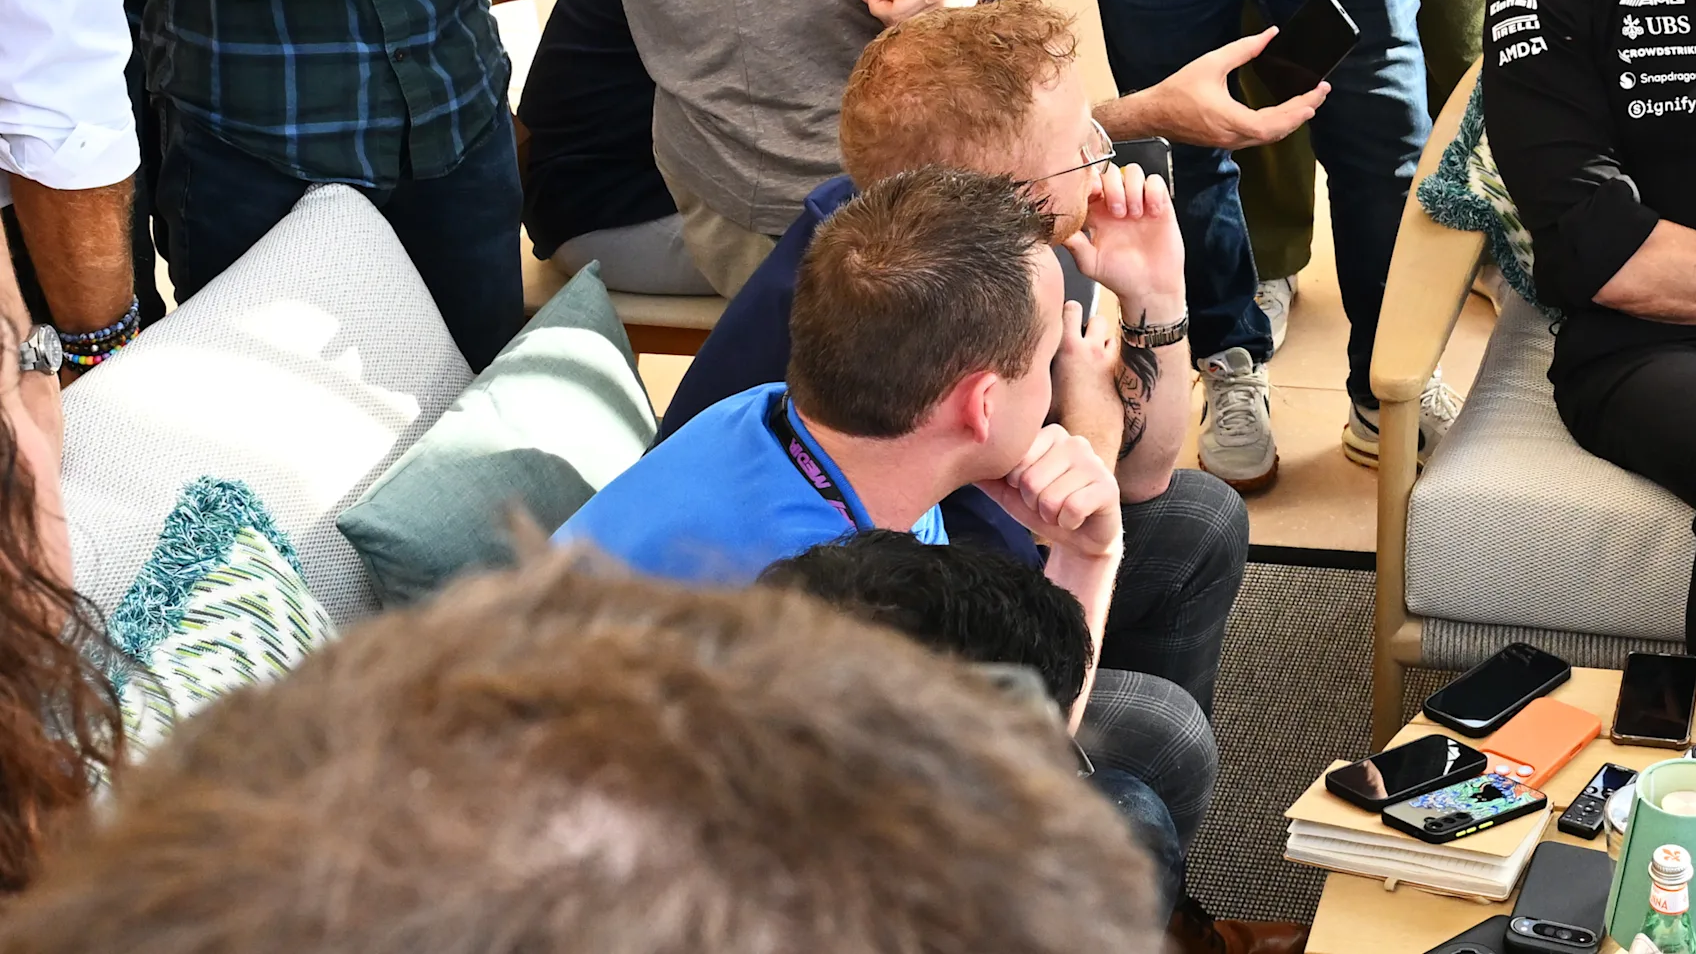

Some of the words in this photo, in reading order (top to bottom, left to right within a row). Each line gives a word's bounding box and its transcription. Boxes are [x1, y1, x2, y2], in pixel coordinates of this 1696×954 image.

[1492, 13, 1541, 42] PIRELLI
[1645, 15, 1691, 35] UBS
[1498, 41, 1531, 67] AMD
[788, 437, 831, 489] MEDIA
